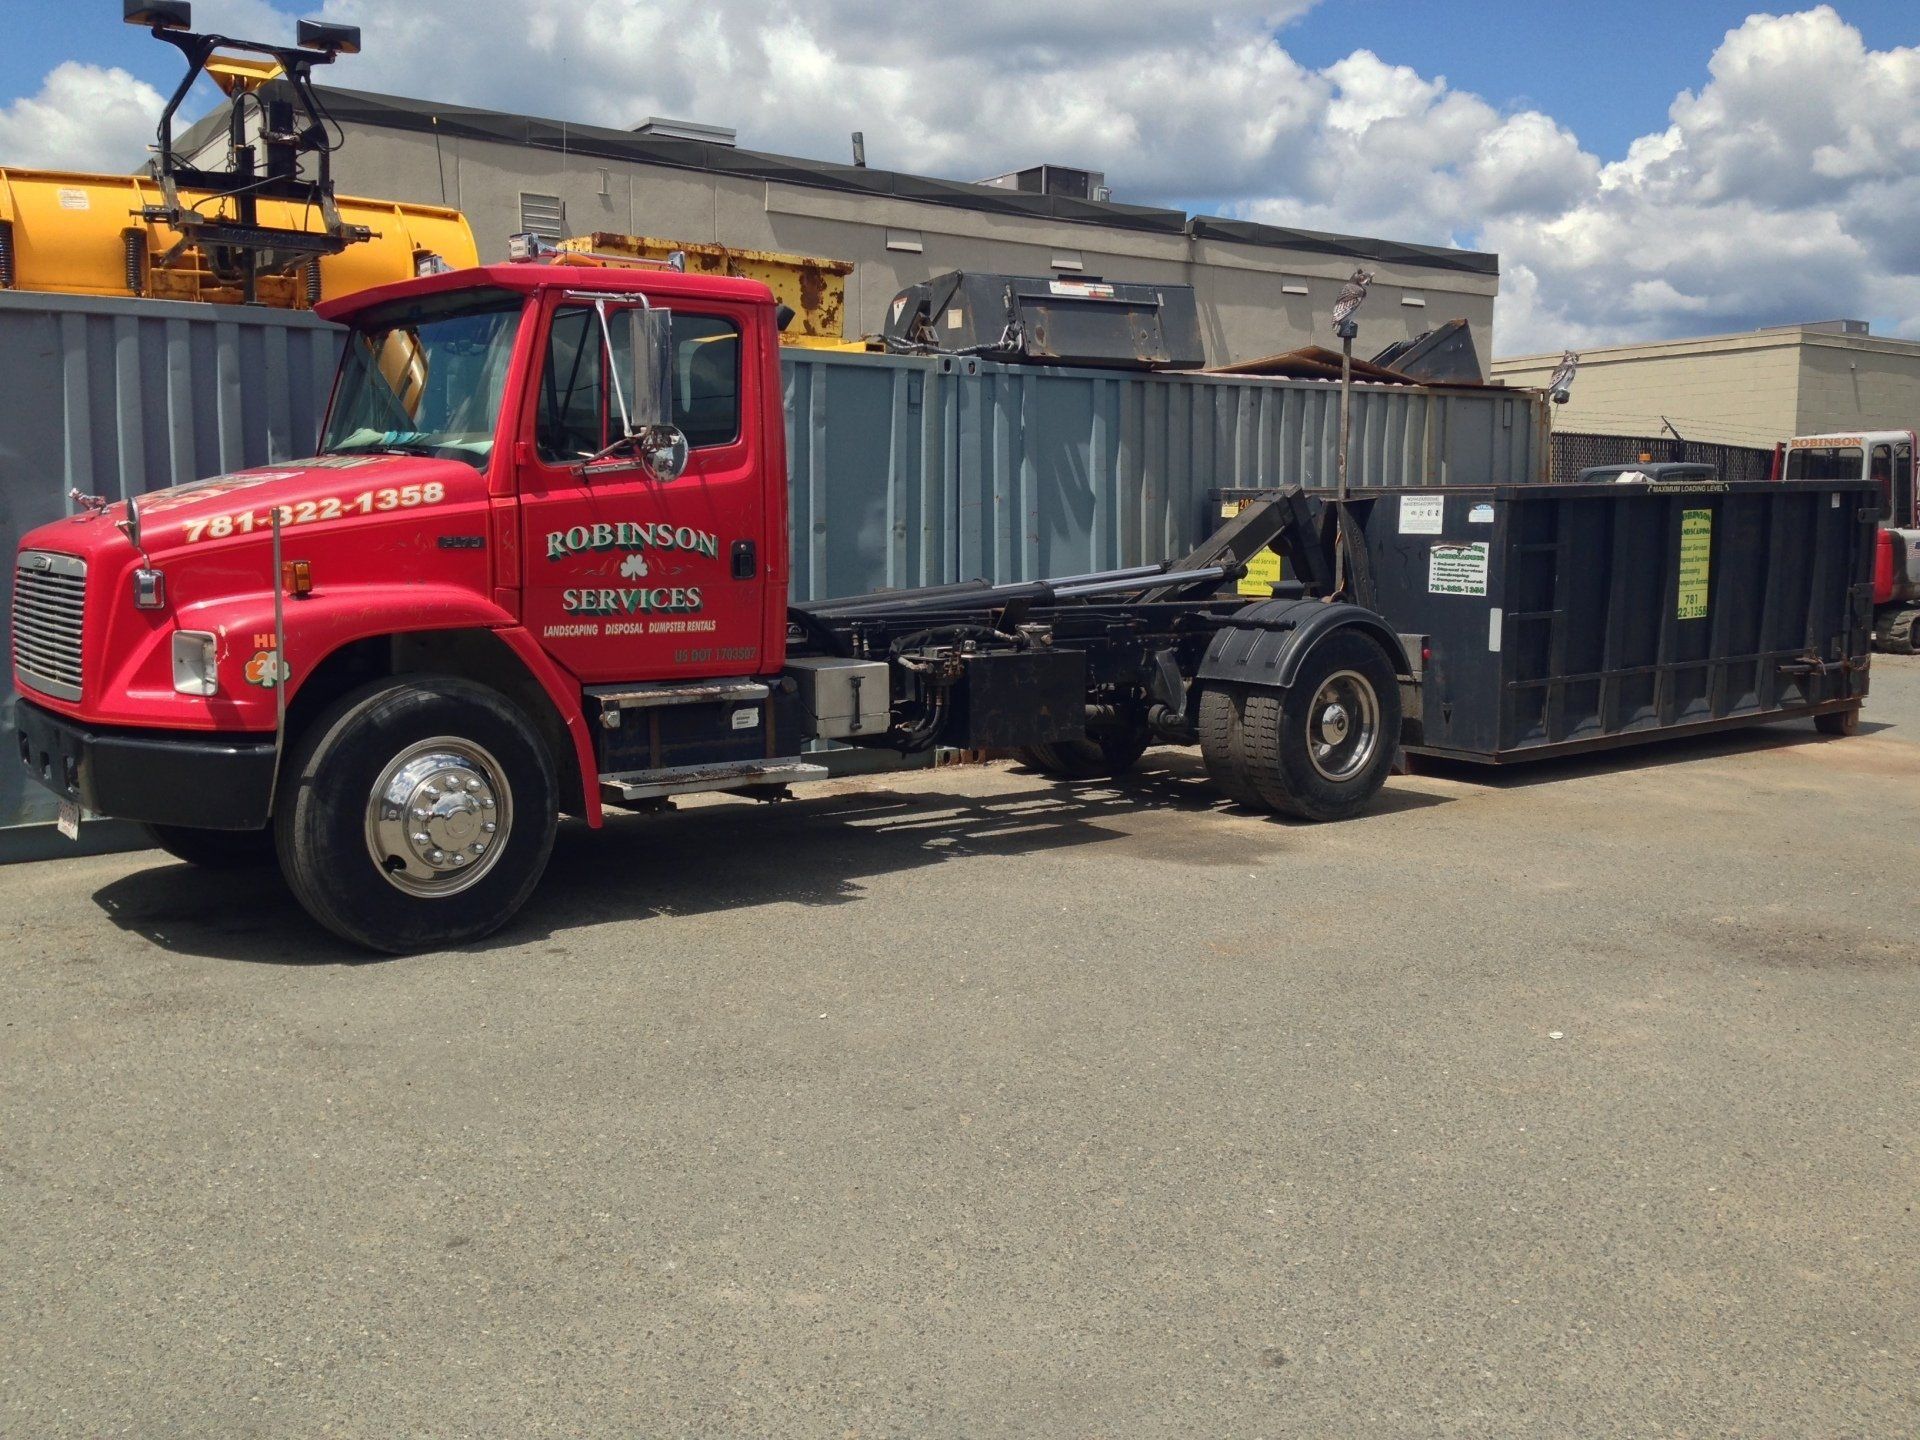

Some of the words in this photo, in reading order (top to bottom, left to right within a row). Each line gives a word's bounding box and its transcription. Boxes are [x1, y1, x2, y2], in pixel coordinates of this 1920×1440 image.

[1790, 437, 1862, 448] ROBINSON
[1652, 484, 1681, 493] MAXIMUM
[1681, 484, 1705, 492] LOADING
[1706, 483, 1724, 492] LEVEL
[182, 481, 445, 543] 781-322-1358
[545, 522, 718, 560] ROBINSON
[563, 587, 703, 613] SERVICES
[1685, 594, 1698, 605] 781
[543, 623, 599, 638] LANDSCAPING
[605, 622, 644, 635] DISPOSAL
[649, 621, 685, 633] DUMPSTER
[686, 620, 716, 632] RENTALS
[674, 648, 688, 663] US
[691, 648, 712, 662] DOT
